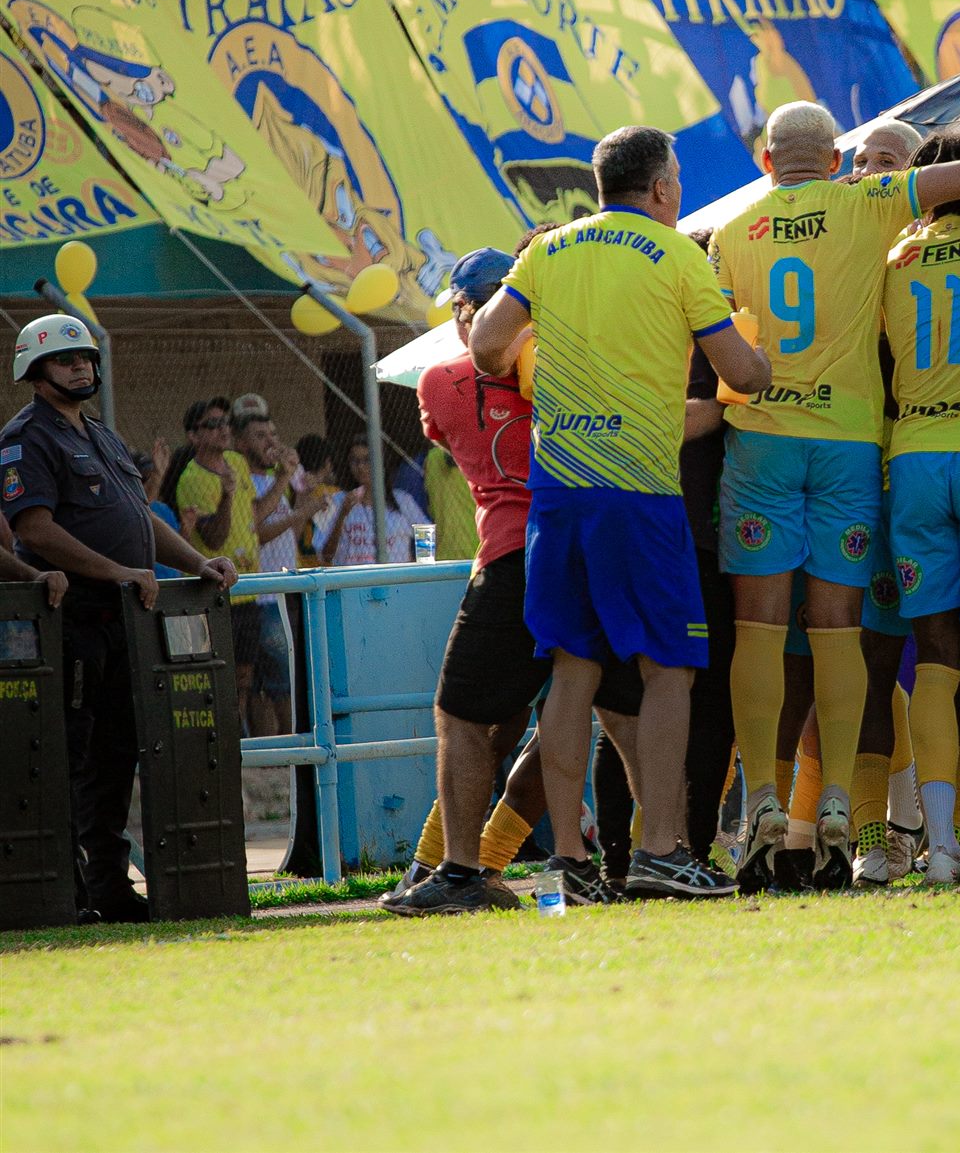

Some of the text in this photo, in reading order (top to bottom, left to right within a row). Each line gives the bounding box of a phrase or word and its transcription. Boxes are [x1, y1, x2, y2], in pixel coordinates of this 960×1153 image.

[773, 210, 828, 243] FENIX
[547, 236, 571, 256] A.E.
[769, 256, 816, 355] 9
[38, 331, 48, 345] P
[545, 407, 623, 438] junpe
[172, 672, 211, 694] FORÇA
[172, 707, 215, 729] TÁTICA
